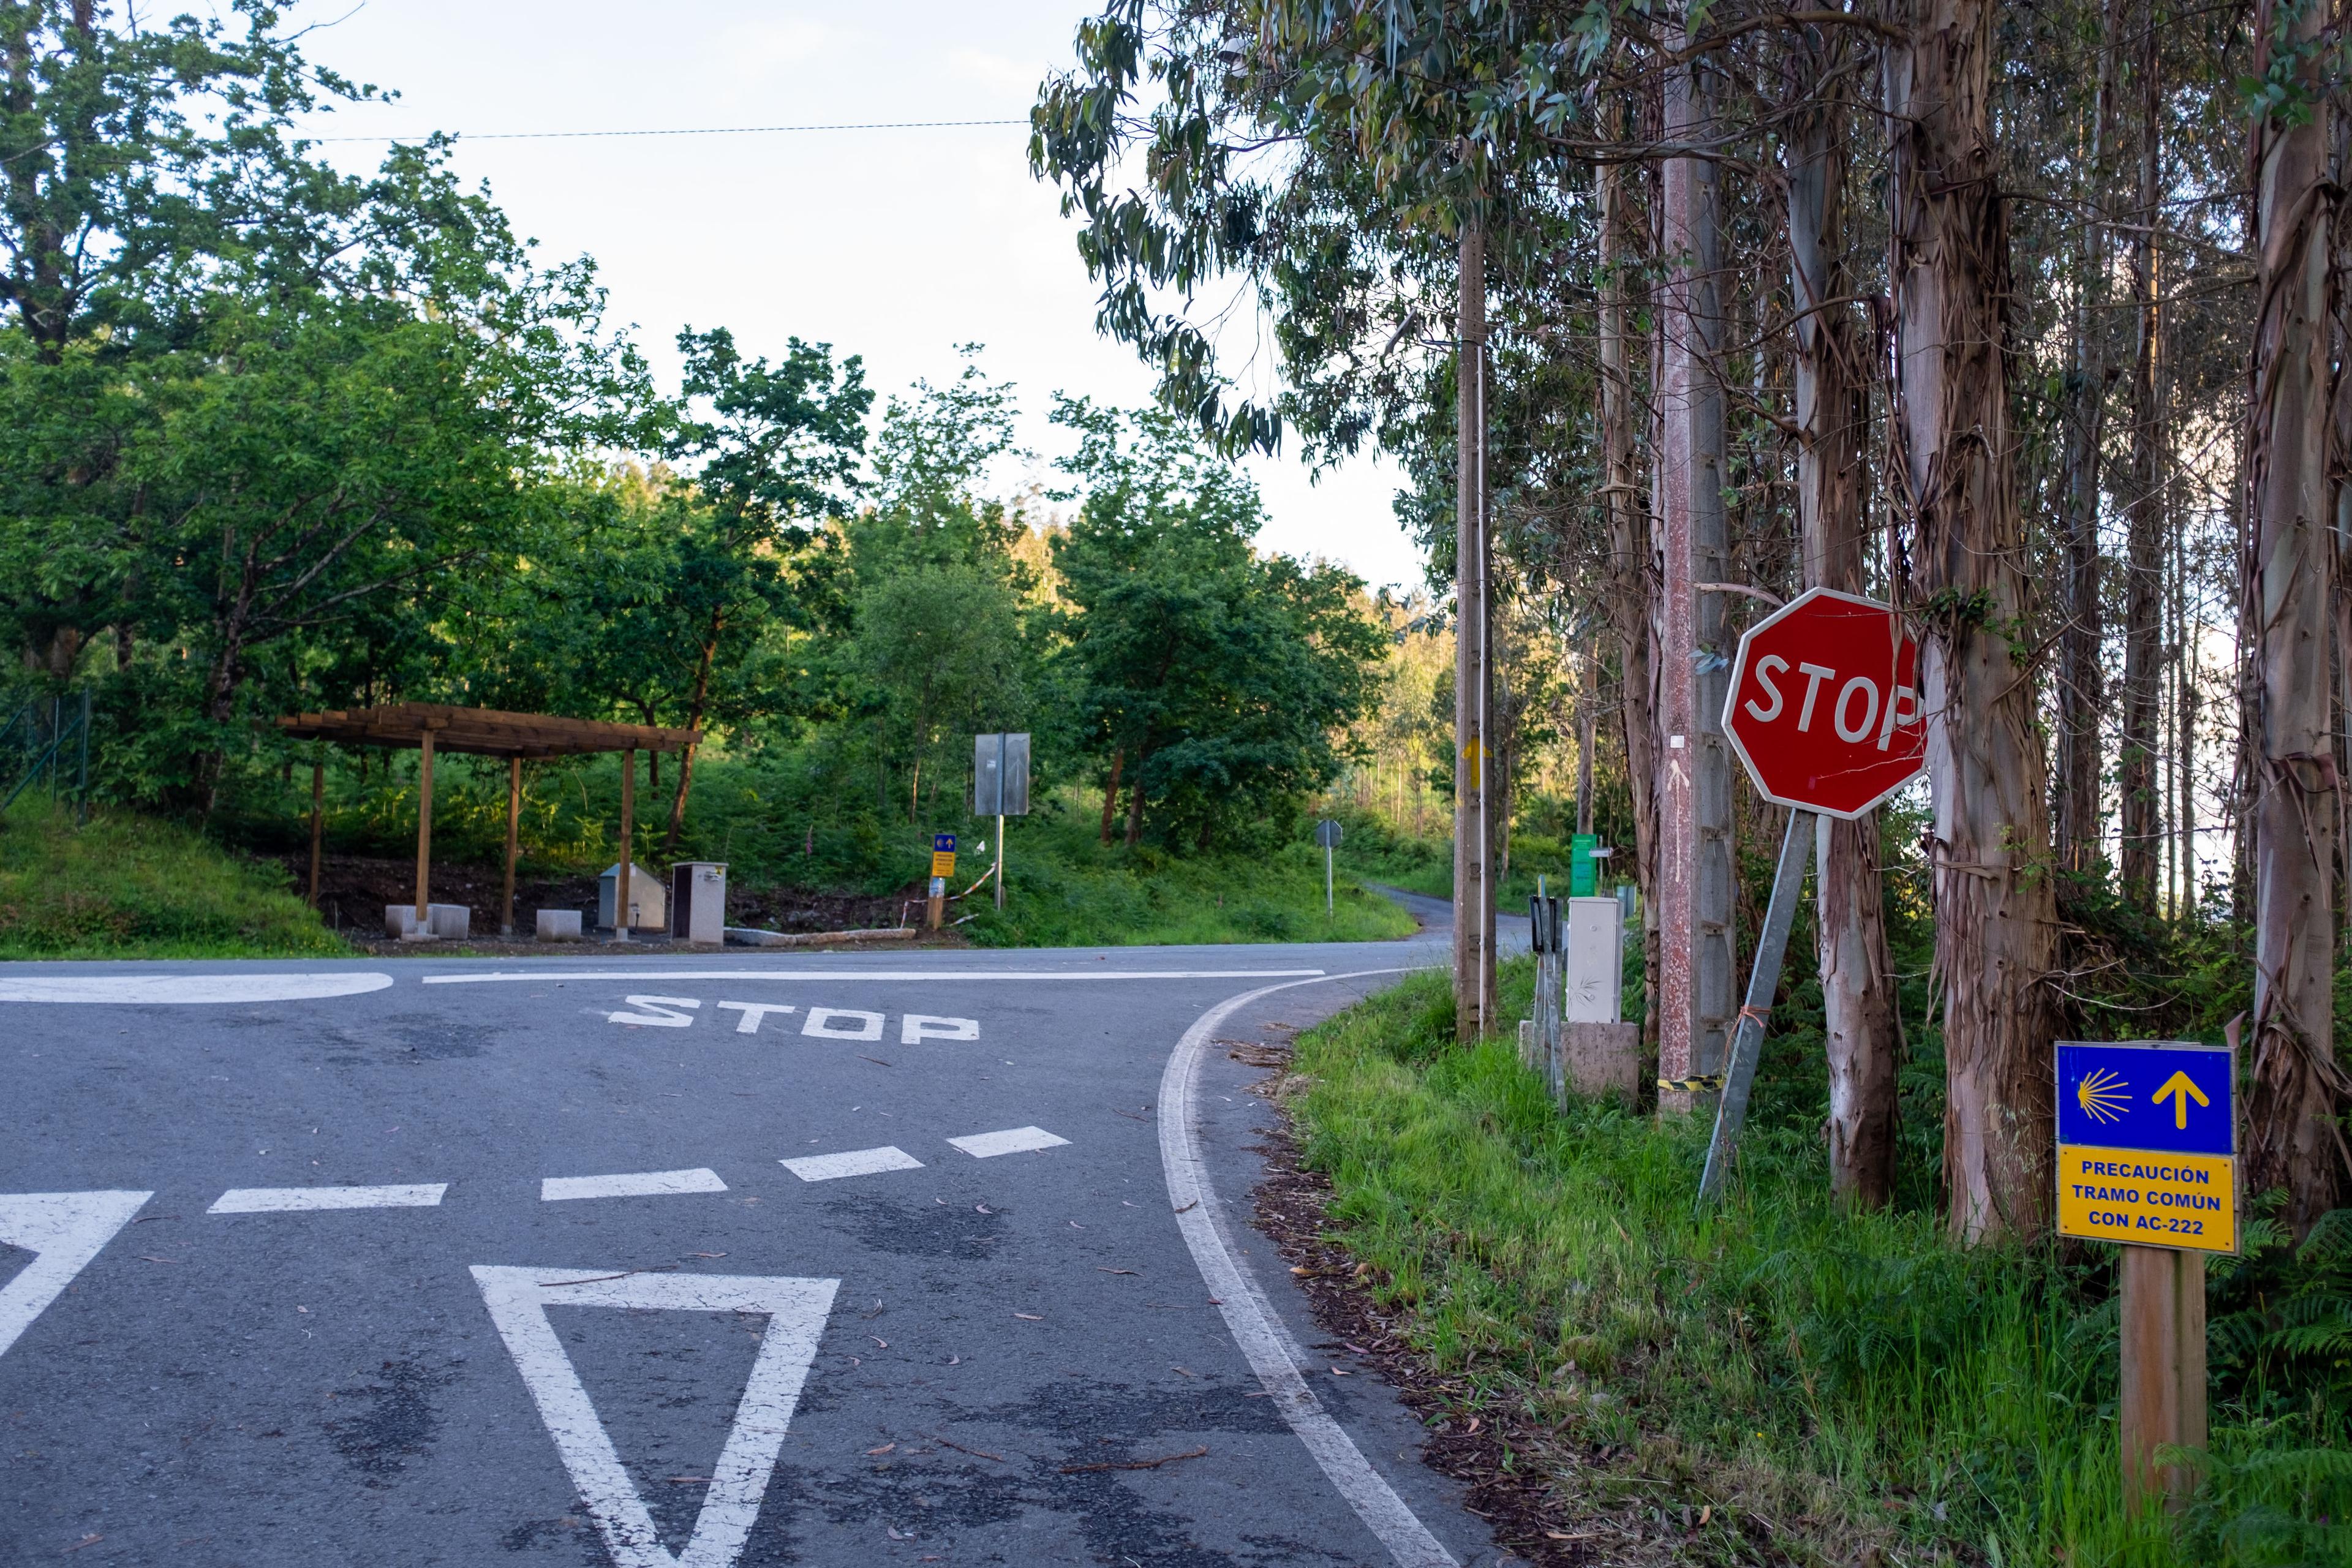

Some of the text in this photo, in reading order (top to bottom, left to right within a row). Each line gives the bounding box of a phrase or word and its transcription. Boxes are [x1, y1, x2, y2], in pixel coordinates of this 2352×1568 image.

[1744, 654, 1925, 752] STOP
[608, 995, 980, 1045] STOP
[2082, 1161, 2209, 1184] PRECAUCIÓN
[2072, 1185, 2220, 1211] TRAMO COMÚN
[2089, 1211, 2203, 1235] CON AC-222
